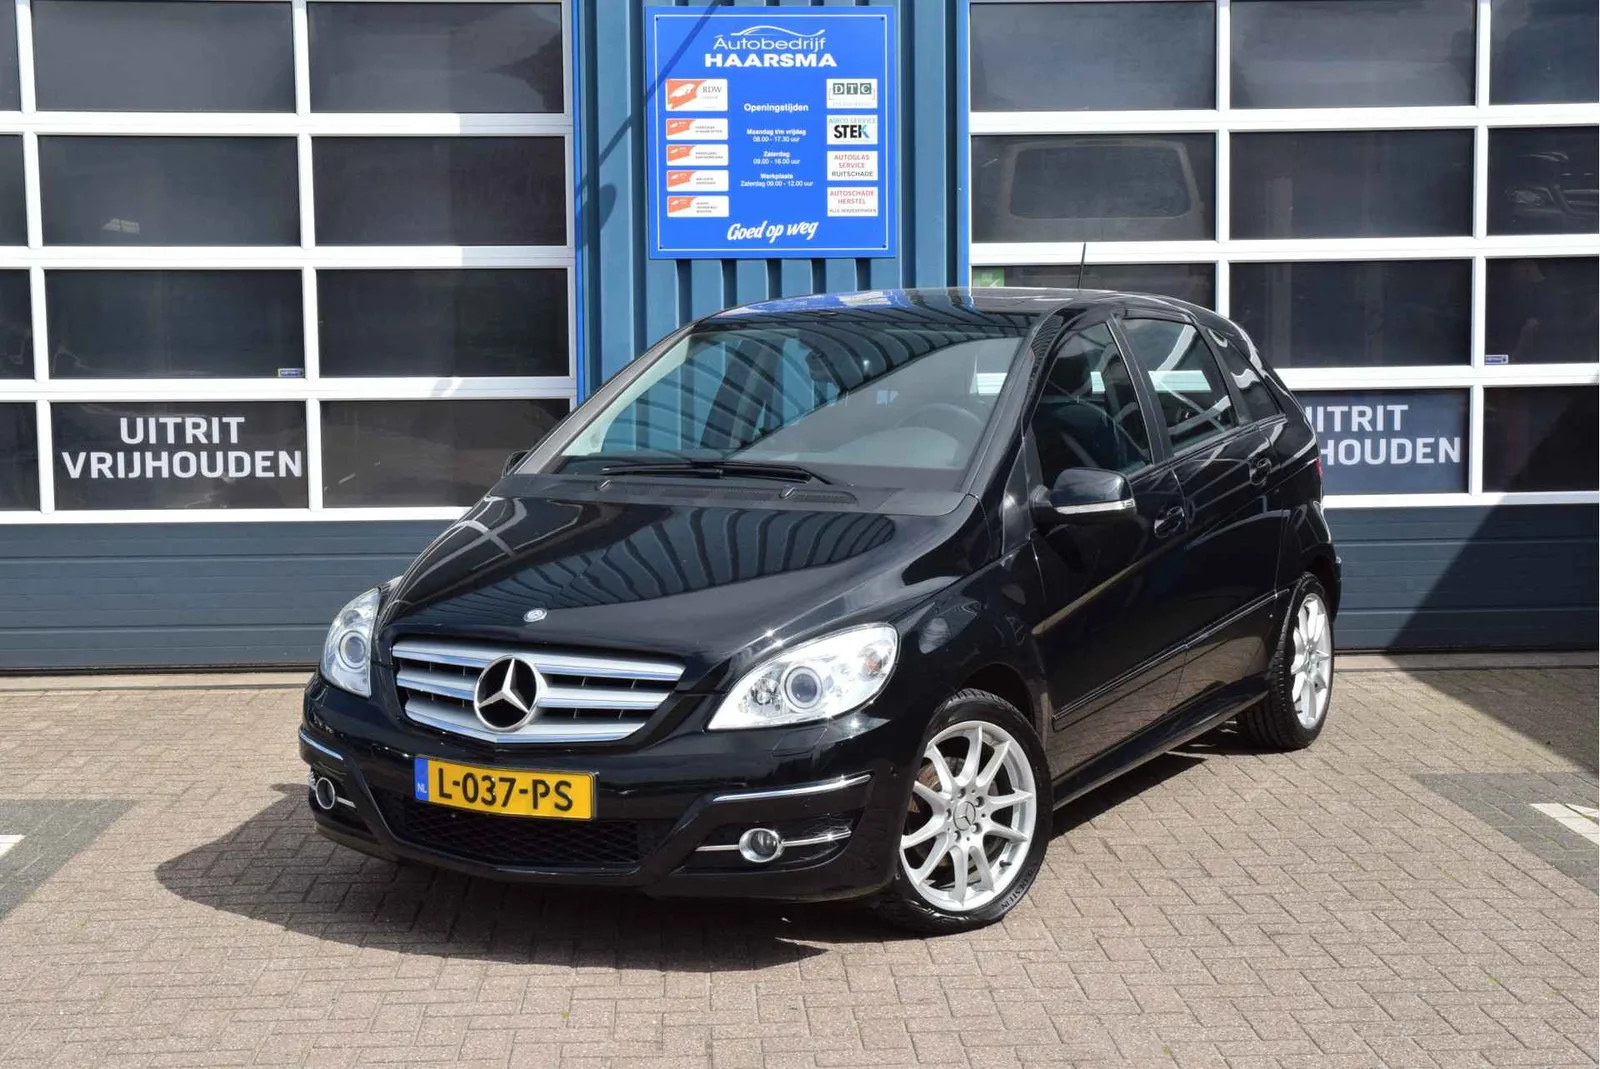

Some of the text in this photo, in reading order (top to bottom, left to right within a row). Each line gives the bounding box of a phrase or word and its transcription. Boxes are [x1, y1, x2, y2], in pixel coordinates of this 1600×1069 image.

[713, 37, 826, 52] Autobedrijf
[704, 53, 837, 68] HAARSMA
[833, 83, 872, 95] DTC
[743, 102, 809, 114] Openingstijden
[746, 128, 774, 136] Maandag
[786, 128, 807, 136] vrijdag
[834, 124, 870, 139] STEK
[741, 180, 766, 188] Zaterdag
[727, 221, 819, 243] Goed op weg
[120, 416, 245, 444] UITRIT
[1320, 437, 1461, 466] HOUDEN
[61, 451, 302, 479] VRIJHOUDEN
[417, 783, 427, 793] NL
[438, 768, 573, 812] L-037-PS
